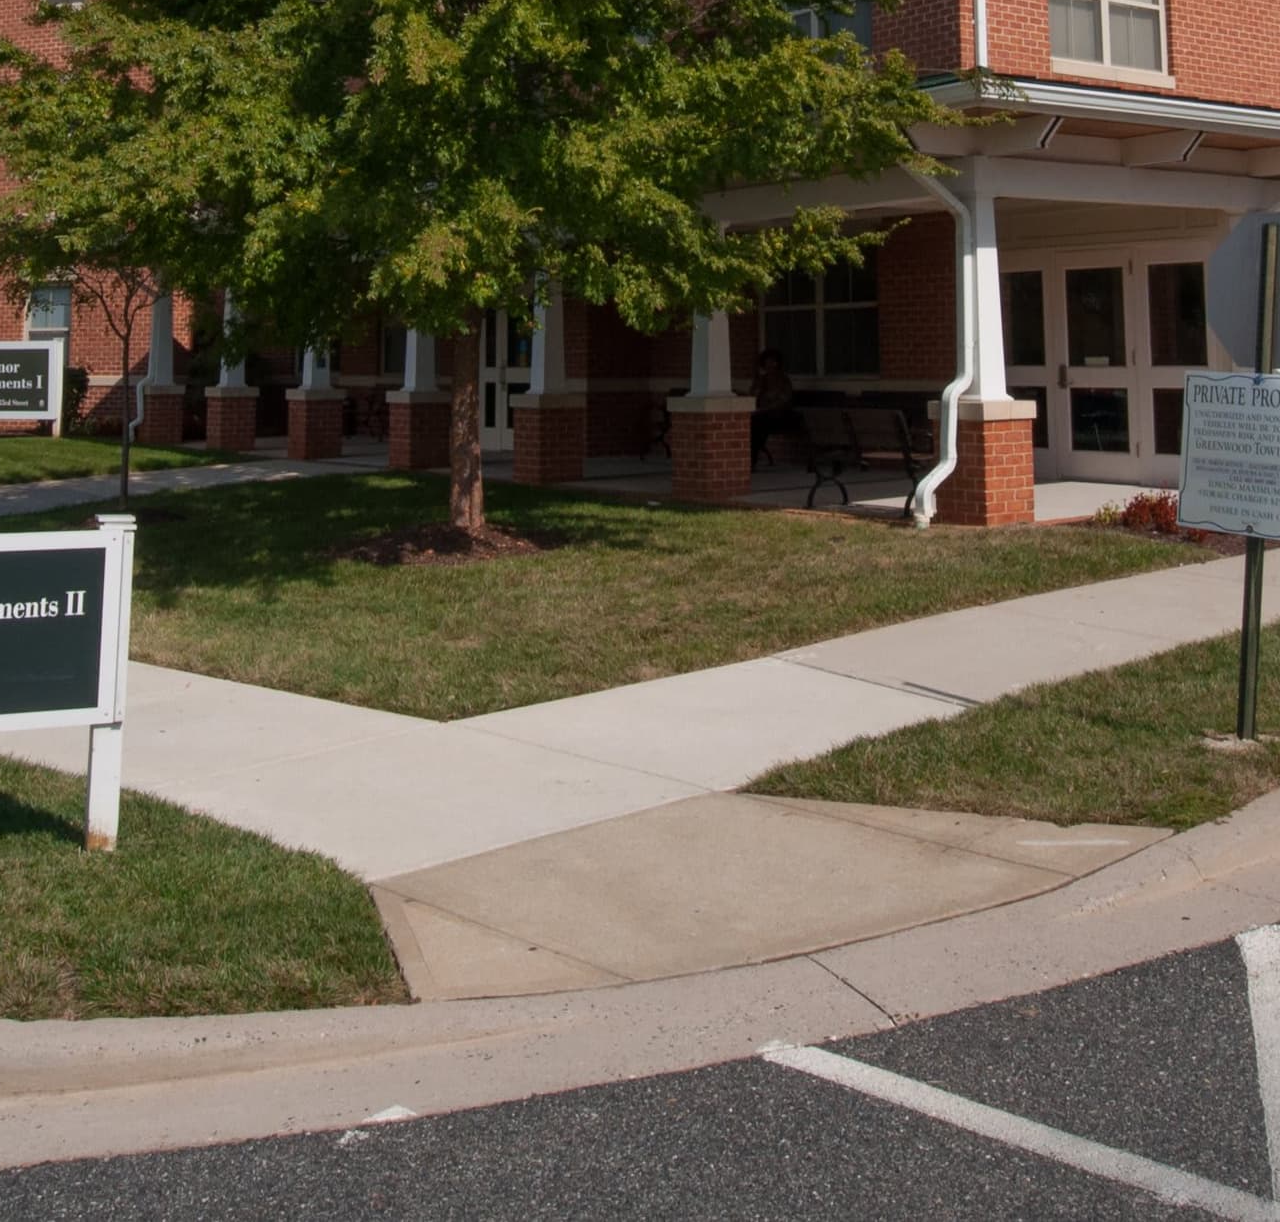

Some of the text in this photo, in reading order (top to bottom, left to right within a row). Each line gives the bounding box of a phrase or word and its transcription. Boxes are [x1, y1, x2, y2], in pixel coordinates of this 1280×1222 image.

[36, 374, 43, 389] I
[1193, 384, 1246, 406] PRIVATE
[1246, 412, 1263, 422] AND
[1238, 421, 1257, 431] WILL
[1258, 432, 1274, 443] AND
[1195, 441, 1252, 455] GREENWOOD
[64, 590, 86, 617] II
